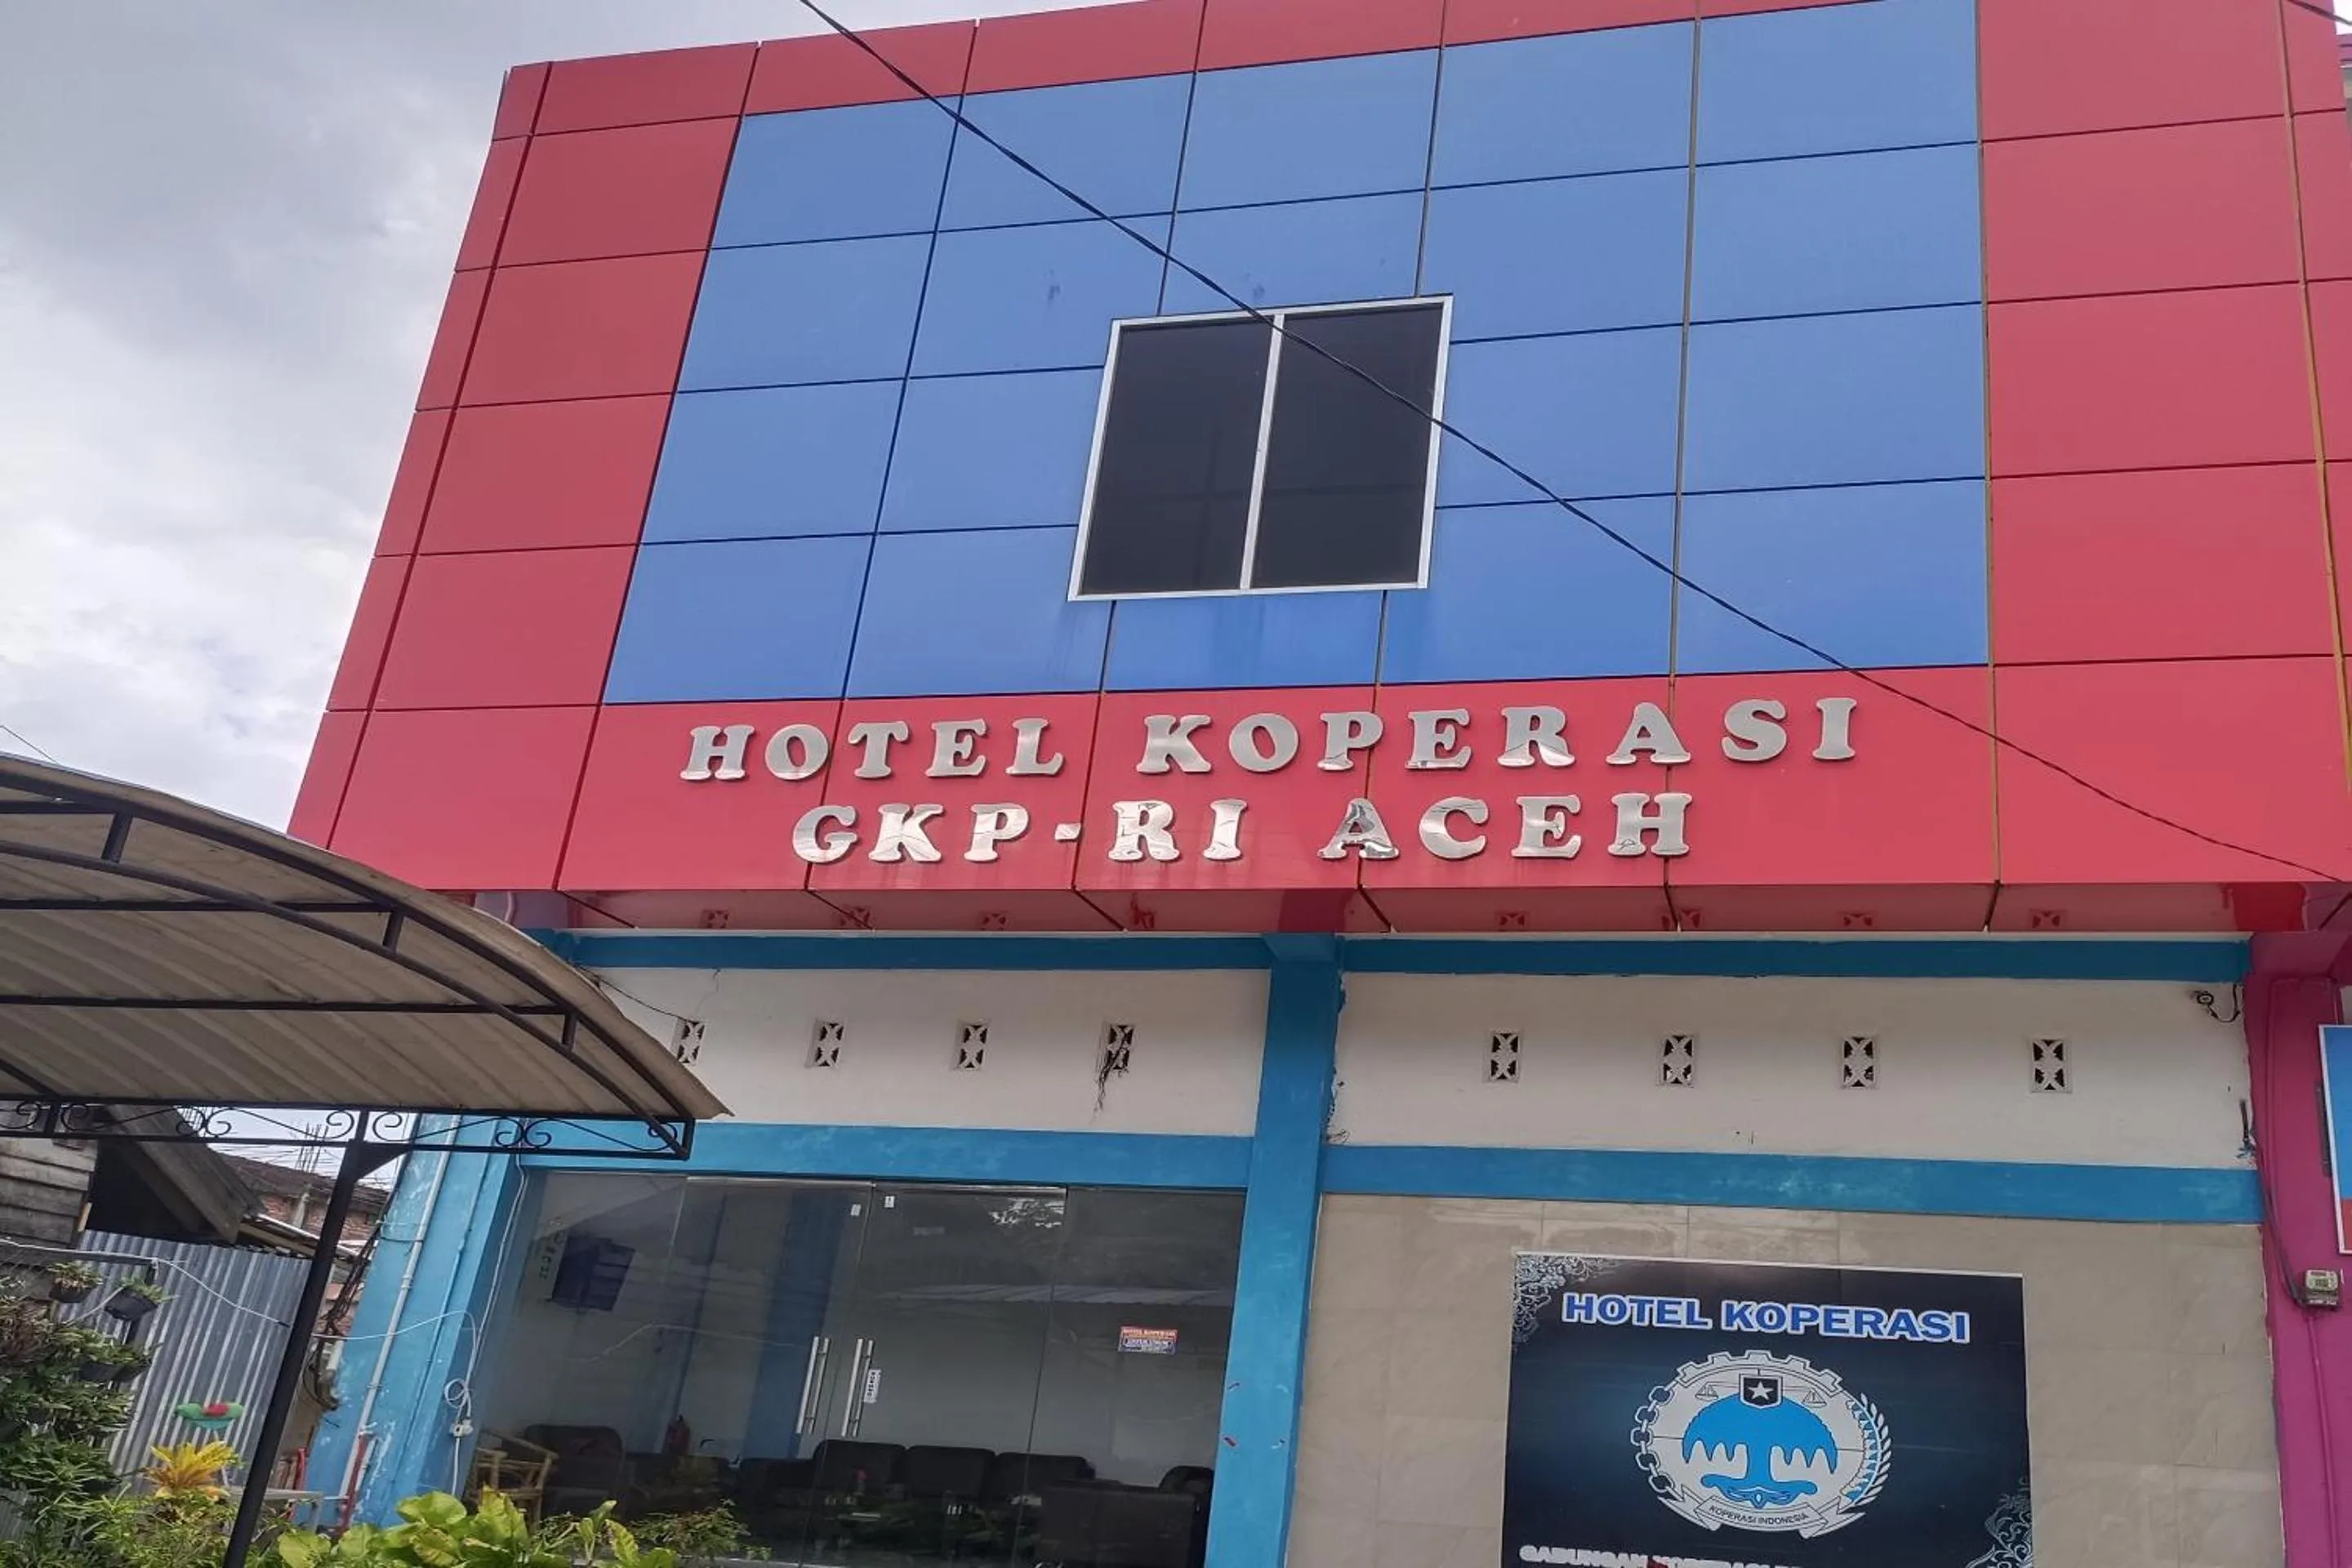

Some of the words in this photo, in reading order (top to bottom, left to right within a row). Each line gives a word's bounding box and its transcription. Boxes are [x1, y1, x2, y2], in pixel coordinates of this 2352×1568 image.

[679, 717, 1064, 780] HOTEL
[1135, 697, 1857, 774] KOPERASI
[791, 799, 1250, 864] GKP-RI
[1316, 792, 1694, 860] ACEH
[1561, 1292, 1713, 1330] HOTEL
[1721, 1300, 1971, 1344] KOPERASI
[1708, 1504, 1755, 1524] KOPERASI
